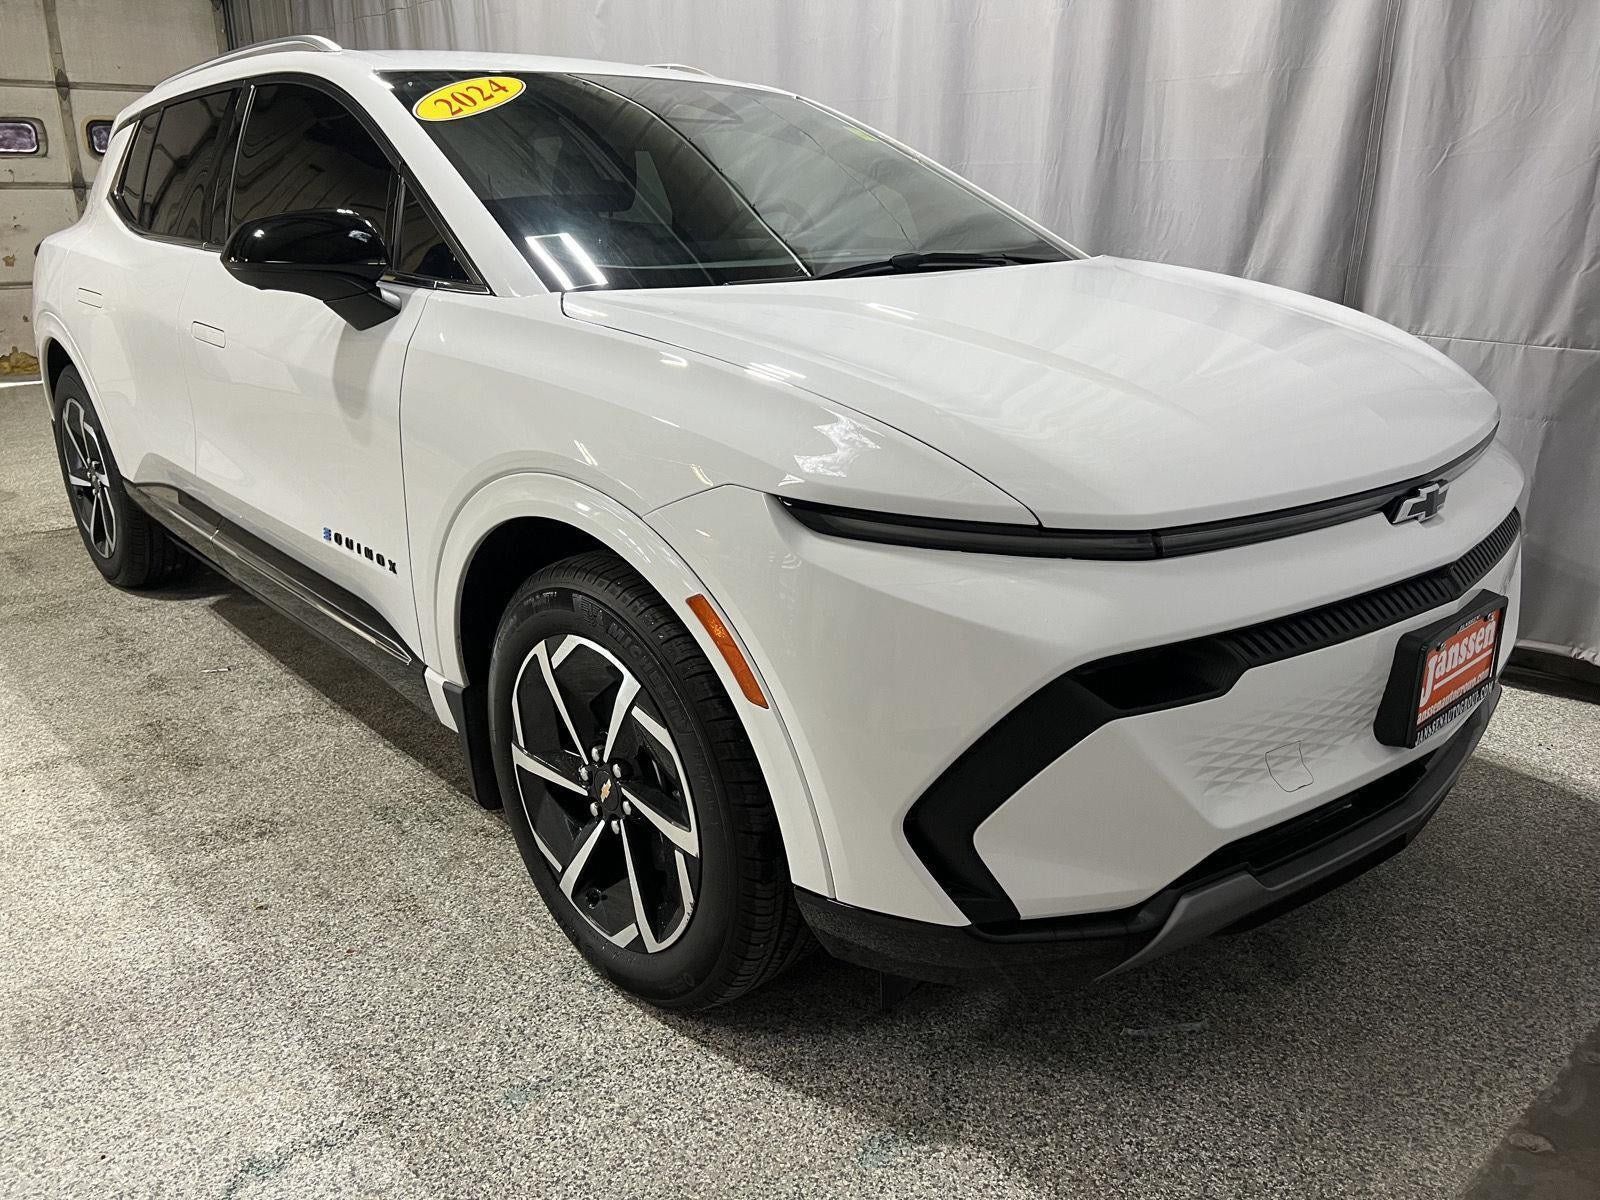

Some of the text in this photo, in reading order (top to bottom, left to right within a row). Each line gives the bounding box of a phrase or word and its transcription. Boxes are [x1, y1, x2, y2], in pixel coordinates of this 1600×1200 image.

[434, 79, 509, 116] 2024
[323, 527, 397, 575] EQUINOX
[1420, 620, 1496, 708] Janssen
